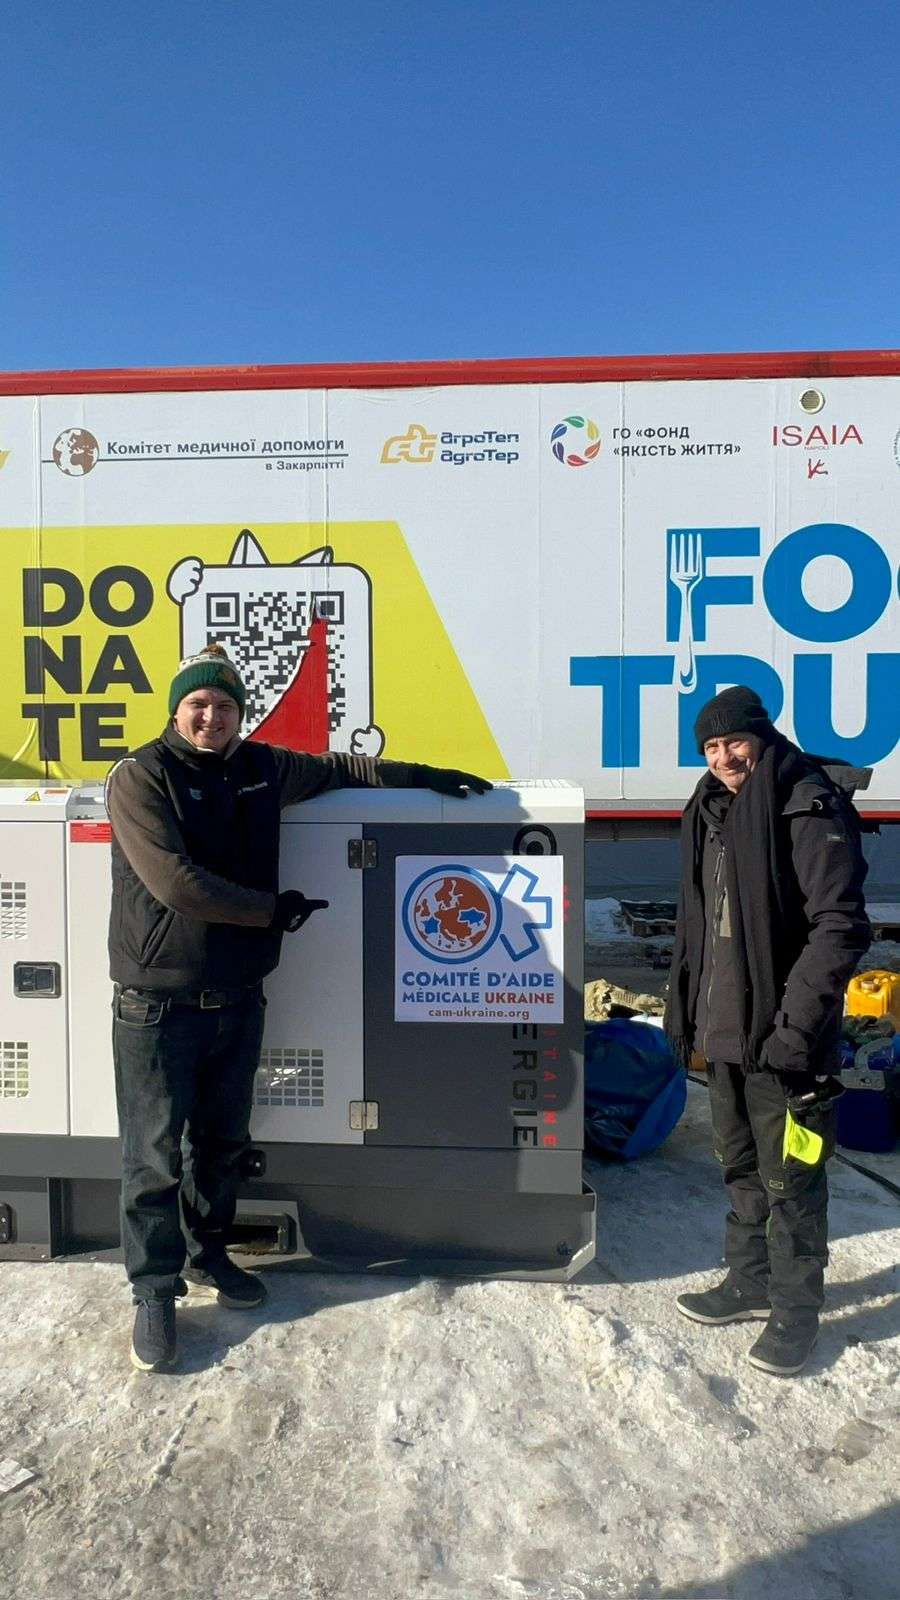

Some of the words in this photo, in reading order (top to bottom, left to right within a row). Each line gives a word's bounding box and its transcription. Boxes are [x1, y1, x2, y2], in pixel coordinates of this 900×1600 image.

[612, 428, 631, 439] ГО
[636, 427, 690, 439] «ФОНД
[772, 424, 864, 447] ISAIA
[107, 441, 171, 455] Комітет
[177, 438, 256, 455] медичної
[261, 439, 345, 453] допомоги
[613, 445, 677, 457] «ЯКІСТЬ
[681, 443, 741, 456] ЖИТТЯ»
[265, 463, 273, 471] в
[276, 459, 345, 472] Закарпатті
[666, 523, 900, 643] FO
[22, 565, 154, 628] DO
[24, 634, 154, 694] NA
[22, 702, 129, 762] TE
[402, 967, 480, 986] COMITÉ
[487, 973, 555, 987] D'AIDE
[402, 988, 480, 1003] MÉDICALE
[485, 992, 555, 1004] UKRAINE
[428, 1007, 530, 1020] cam-ukraine.org
